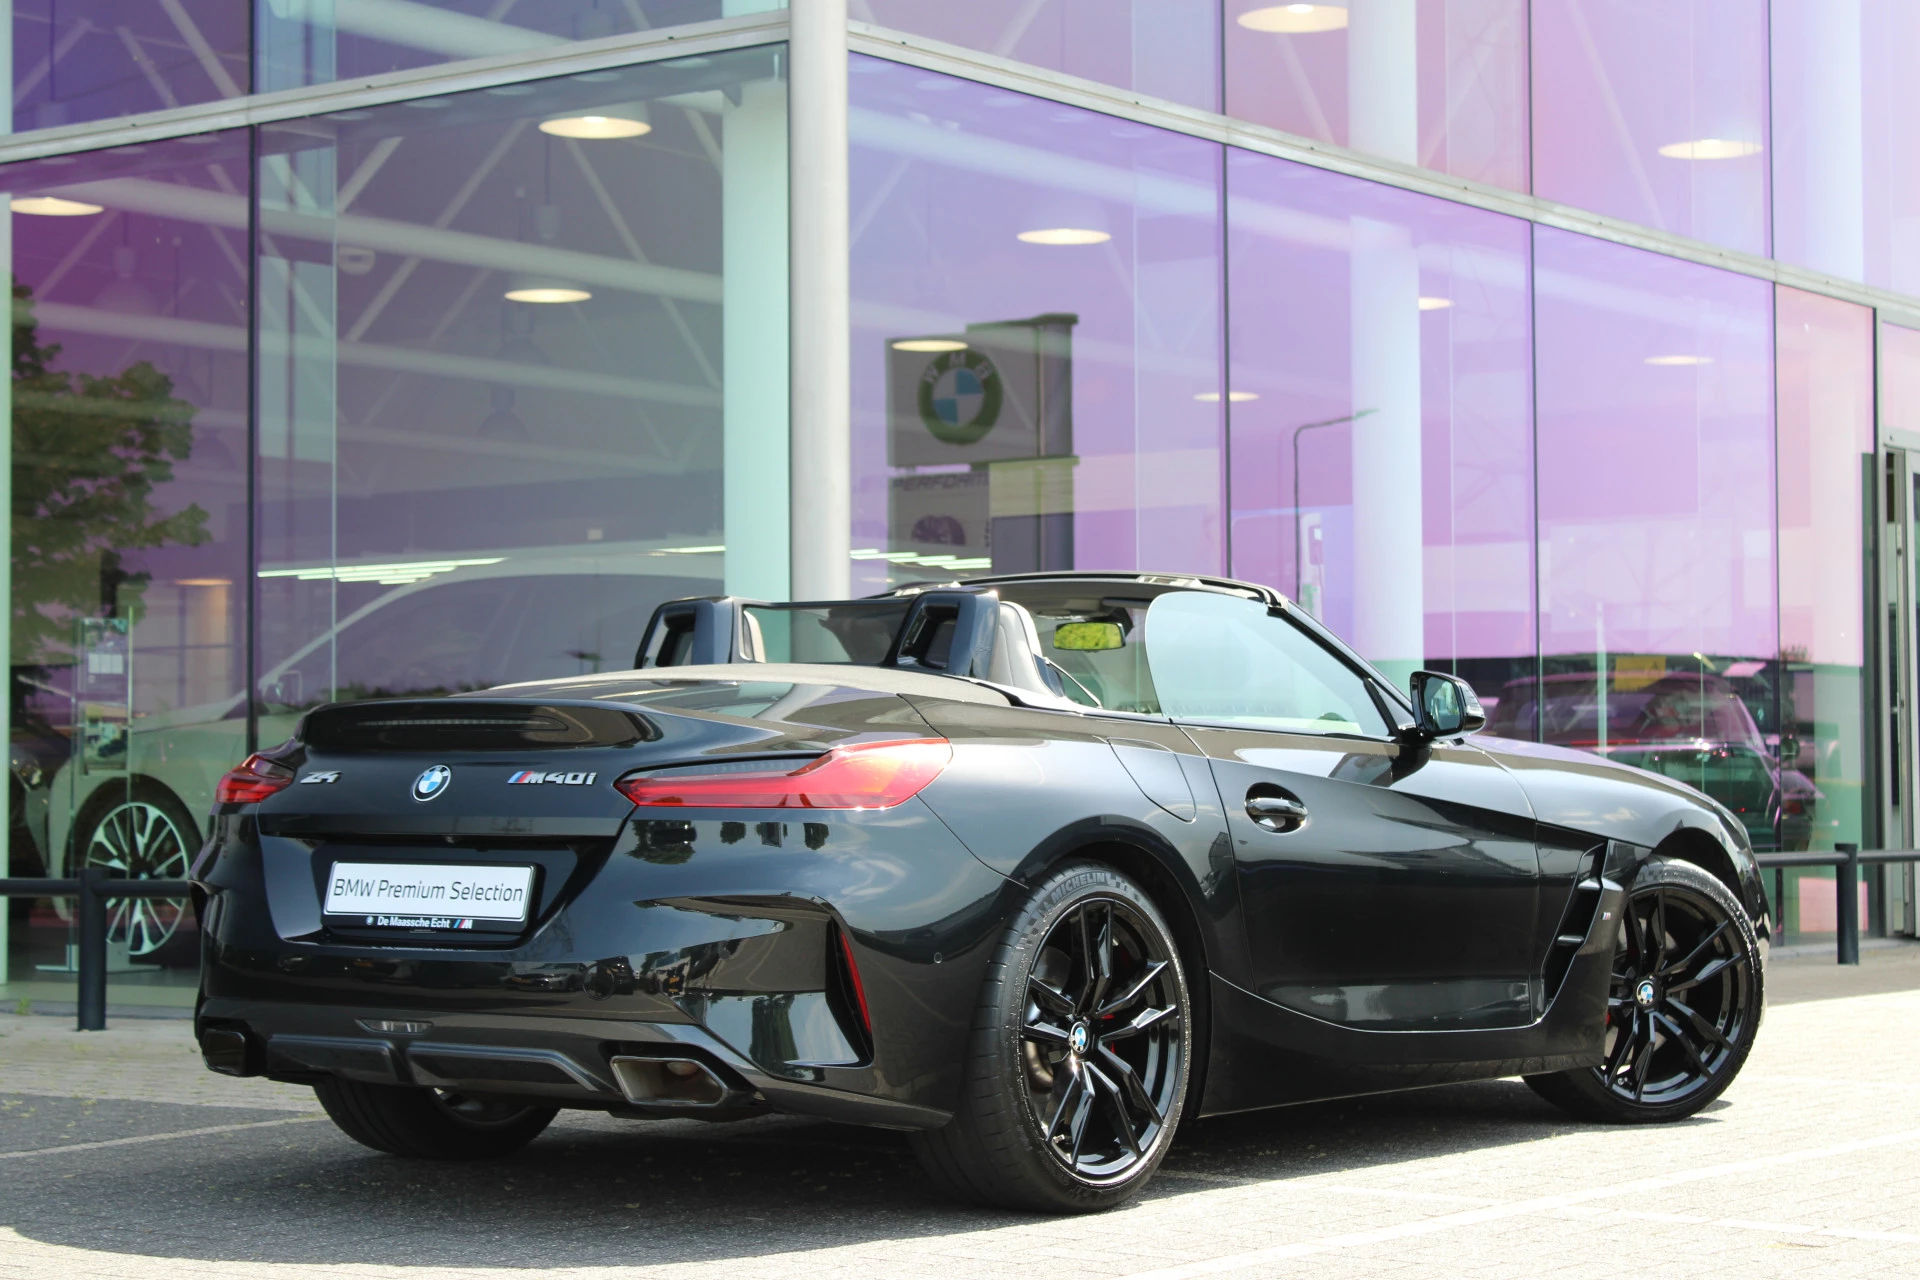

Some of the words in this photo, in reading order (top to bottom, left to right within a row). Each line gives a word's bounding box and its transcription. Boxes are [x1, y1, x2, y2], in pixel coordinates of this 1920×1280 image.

[300, 770, 341, 784] Z4
[522, 771, 597, 785] M40i
[333, 878, 375, 898] BMW
[377, 879, 445, 900] Premium
[450, 881, 524, 902] Selection
[1051, 871, 1106, 904] MICHELIN
[377, 916, 389, 927] De
[390, 917, 430, 928] Maassche
[431, 918, 450, 929] Echt
